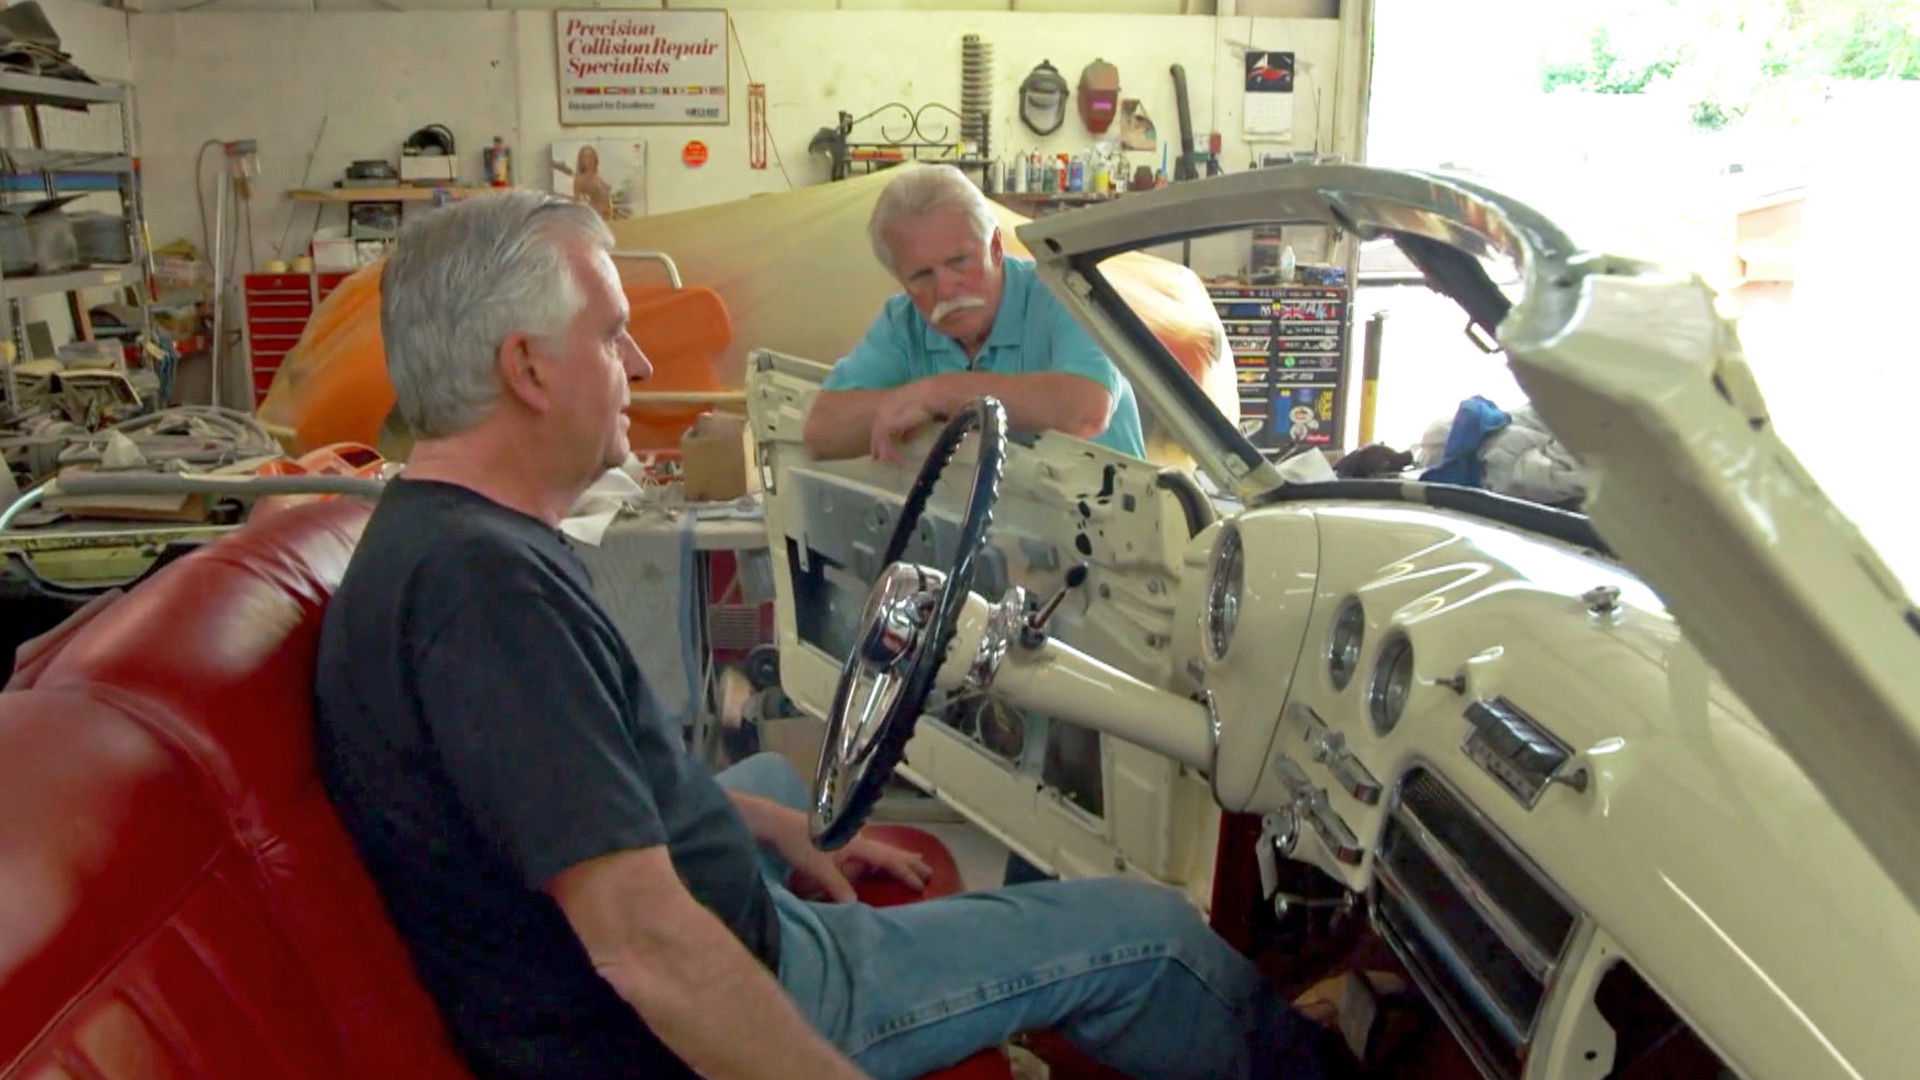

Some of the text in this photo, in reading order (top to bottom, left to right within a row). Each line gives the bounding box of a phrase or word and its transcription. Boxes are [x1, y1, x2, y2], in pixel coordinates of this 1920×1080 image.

[567, 19, 655, 36] Precision
[567, 38, 718, 60] Collision Repair
[567, 57, 670, 78] Specialists
